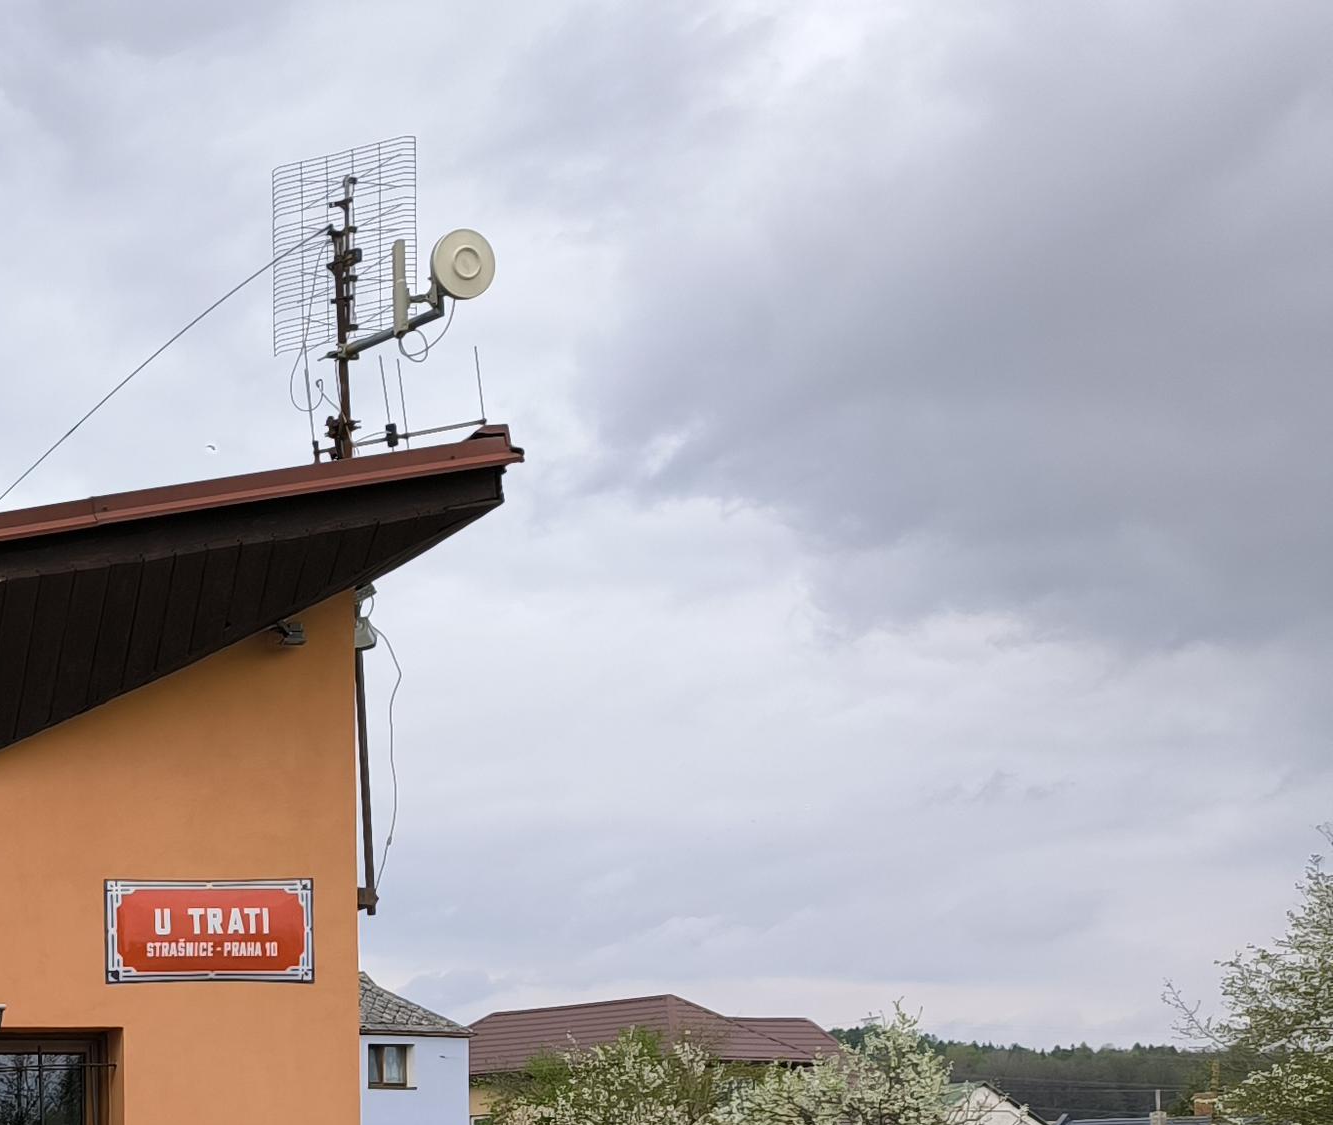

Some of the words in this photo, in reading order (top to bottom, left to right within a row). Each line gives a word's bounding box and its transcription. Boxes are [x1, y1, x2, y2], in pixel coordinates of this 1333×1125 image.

[154, 908, 172, 935] U
[188, 908, 270, 934] TRATI
[146, 939, 214, 957] STRAŠNICE
[224, 942, 262, 957] PRAHA
[265, 942, 278, 957] 10
